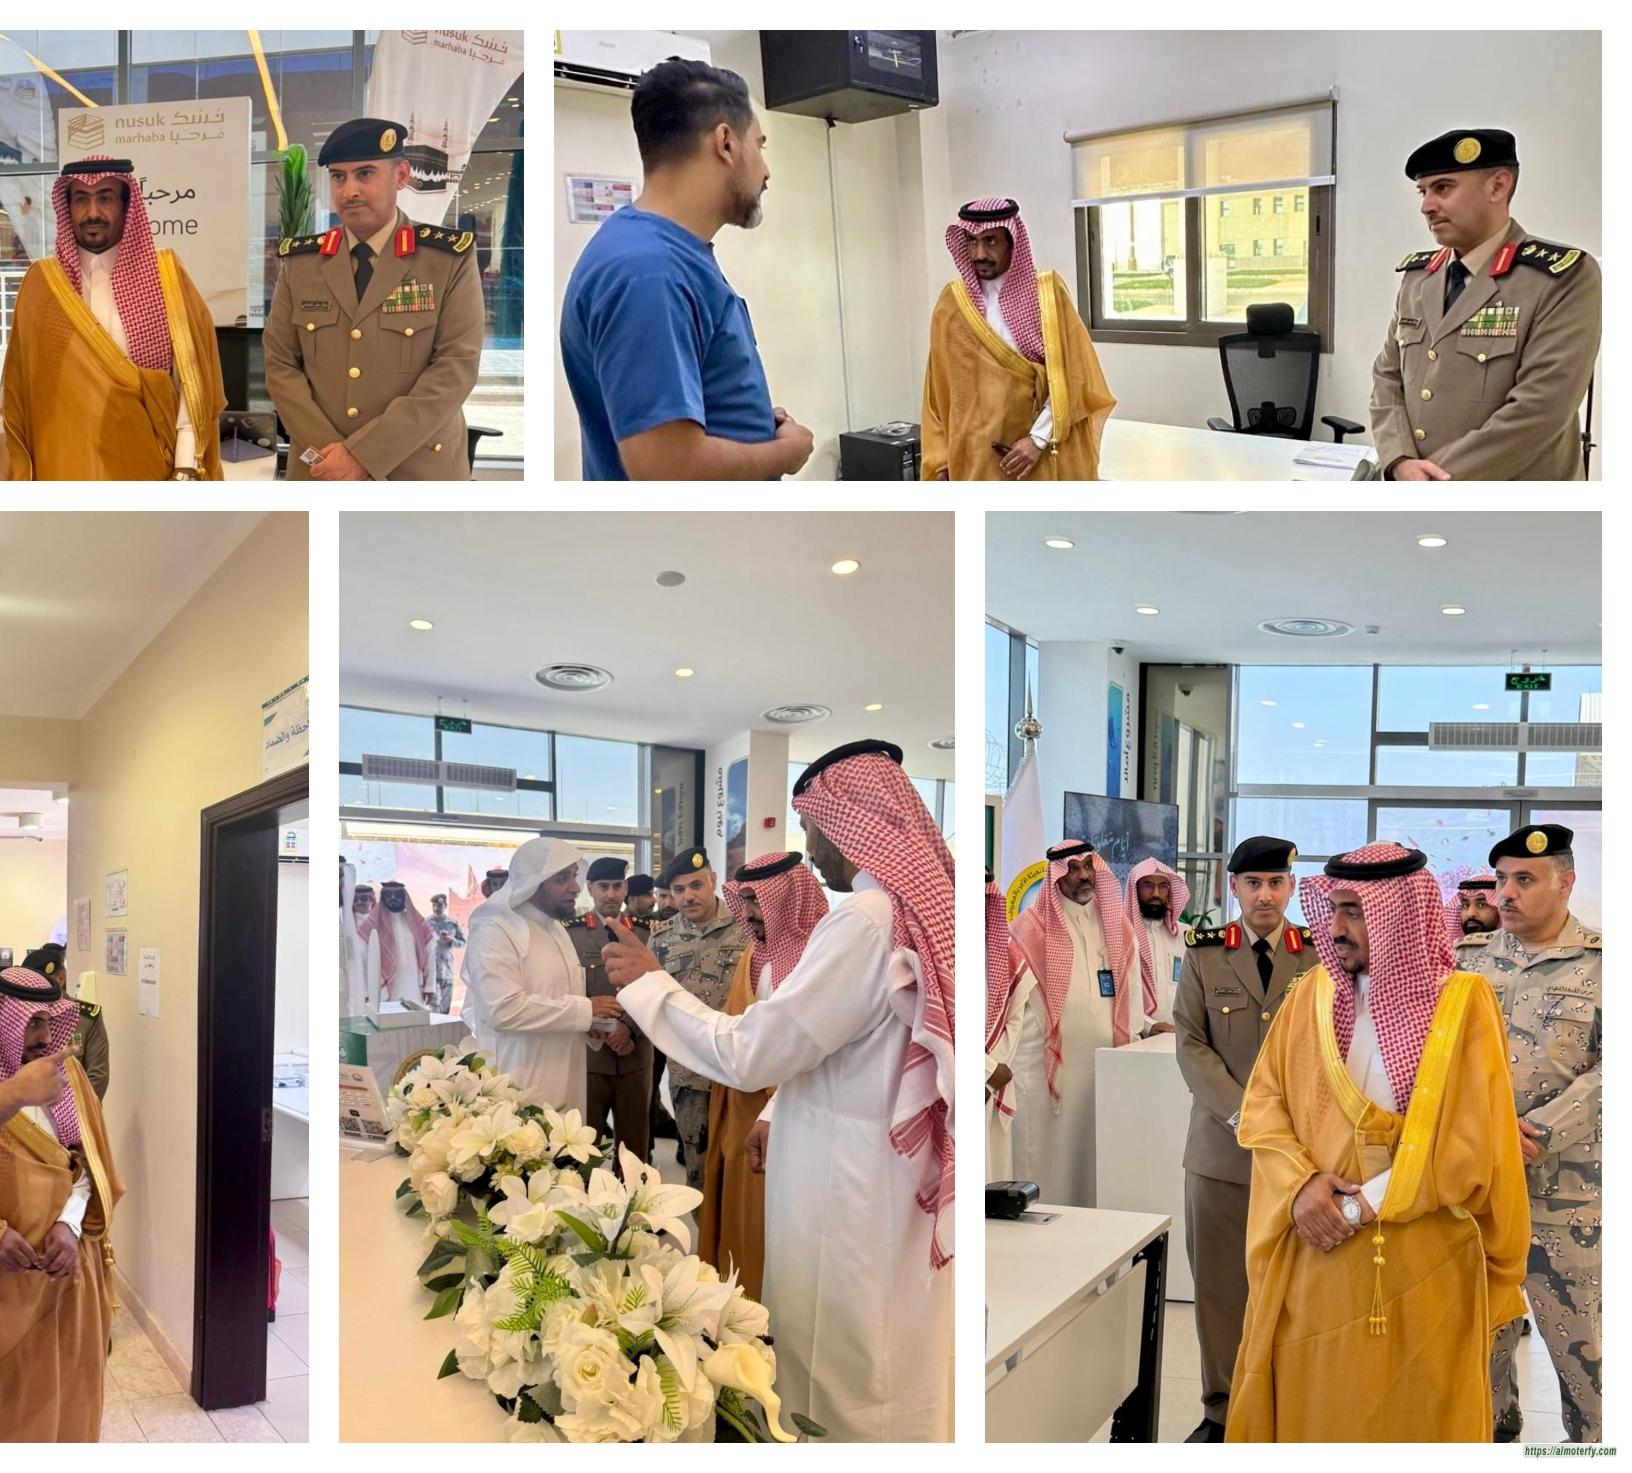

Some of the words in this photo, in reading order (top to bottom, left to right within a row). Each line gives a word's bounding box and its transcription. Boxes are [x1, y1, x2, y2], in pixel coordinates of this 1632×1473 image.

[433, 39, 467, 55] marhaba
[115, 112, 165, 128] nusuk
[115, 129, 165, 144] marhaba
